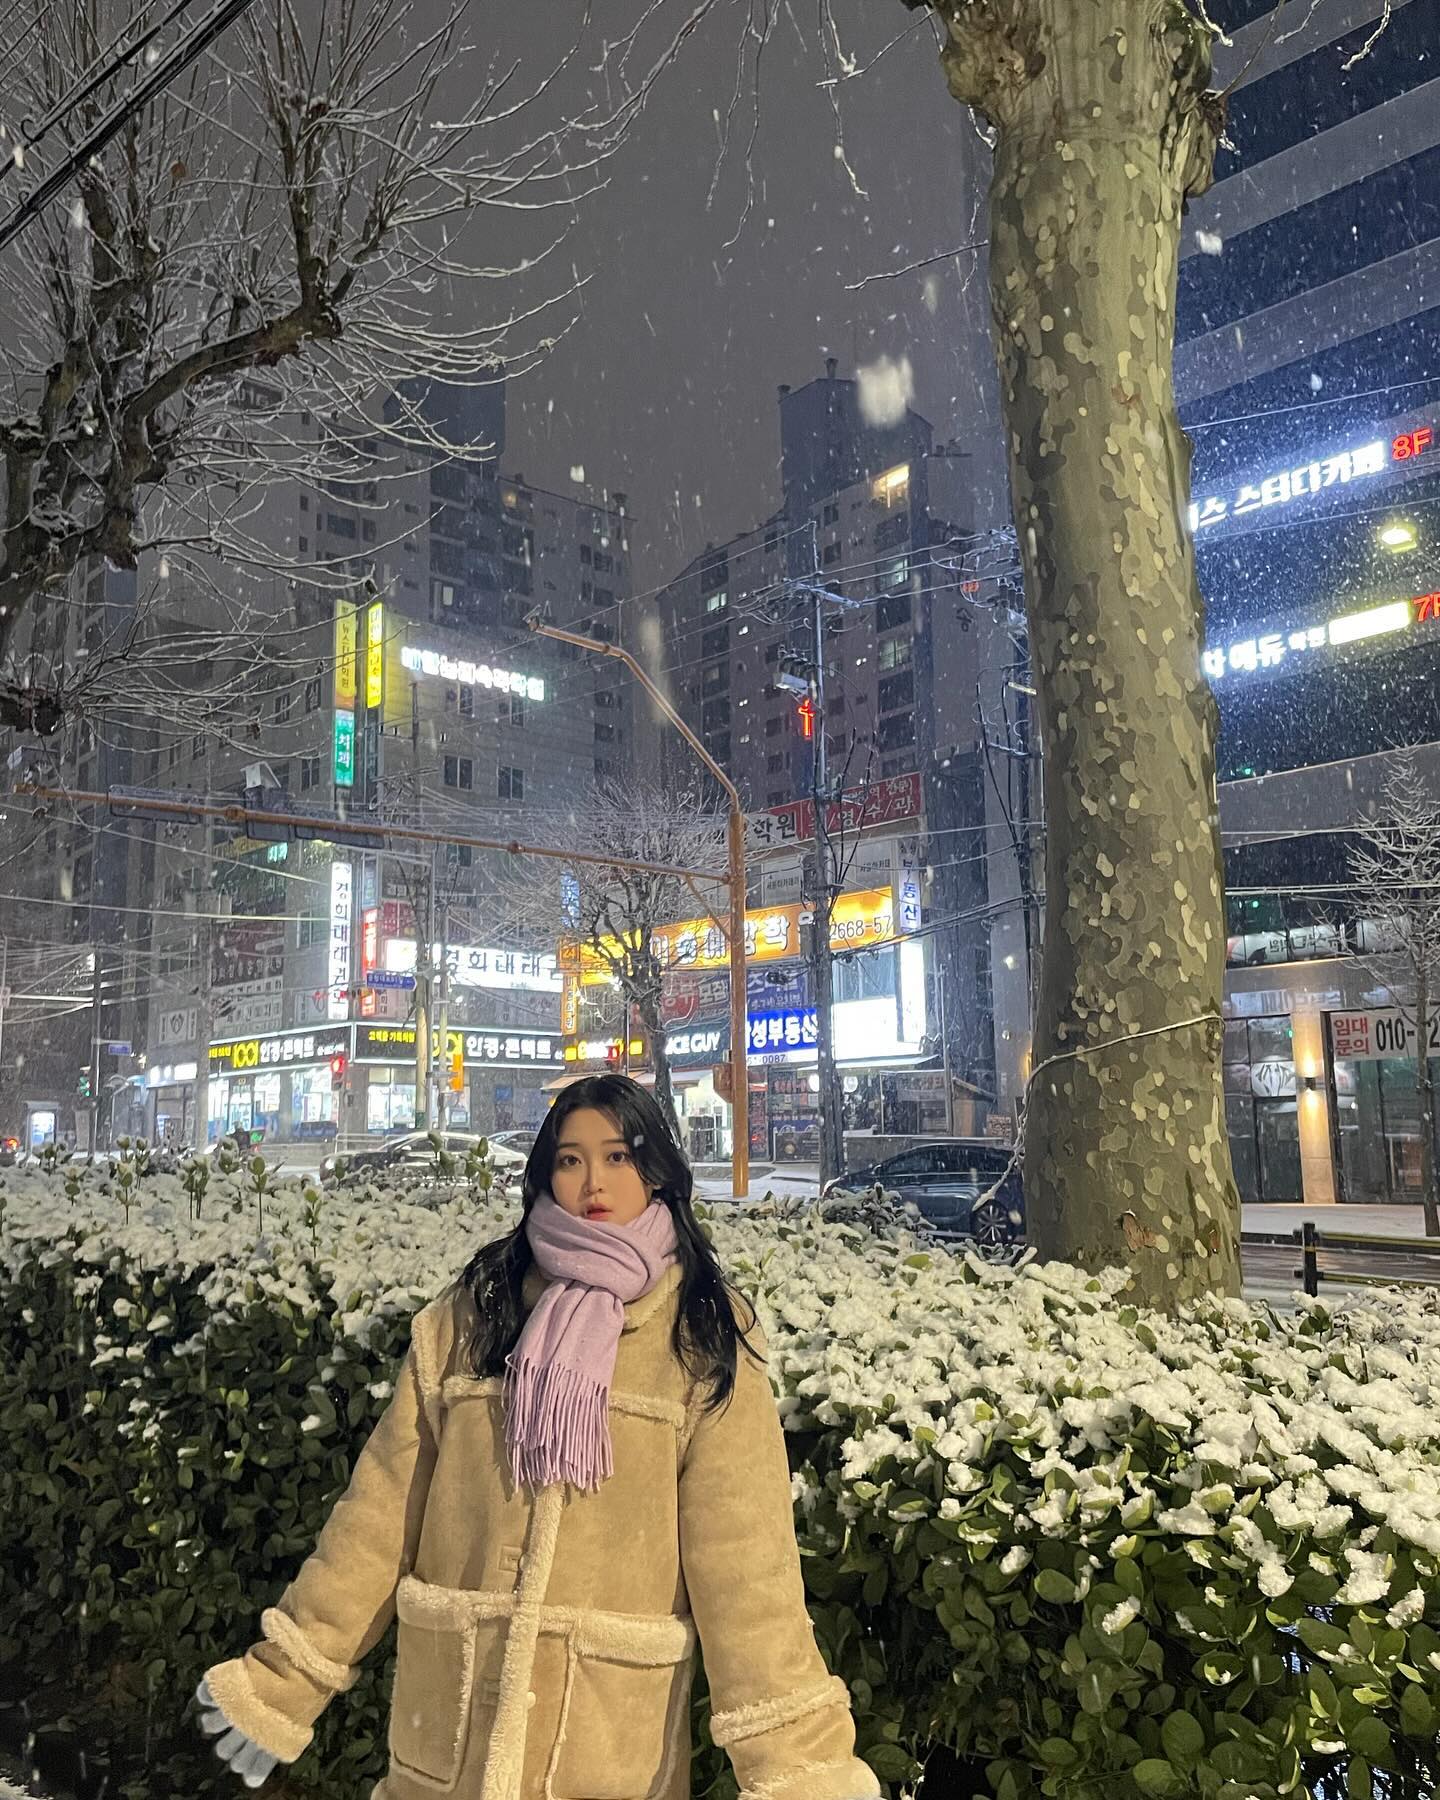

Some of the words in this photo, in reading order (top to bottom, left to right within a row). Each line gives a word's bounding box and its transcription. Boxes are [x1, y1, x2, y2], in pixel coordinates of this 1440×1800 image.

[1234, 441, 1386, 514] 스터디카페
[1391, 428, 1432, 460] 8F
[746, 1015, 818, 1049] 성부동산
[1334, 1017, 1369, 1037] 임대
[690, 1032, 721, 1054] GUY
[1335, 1037, 1370, 1057] 문의
